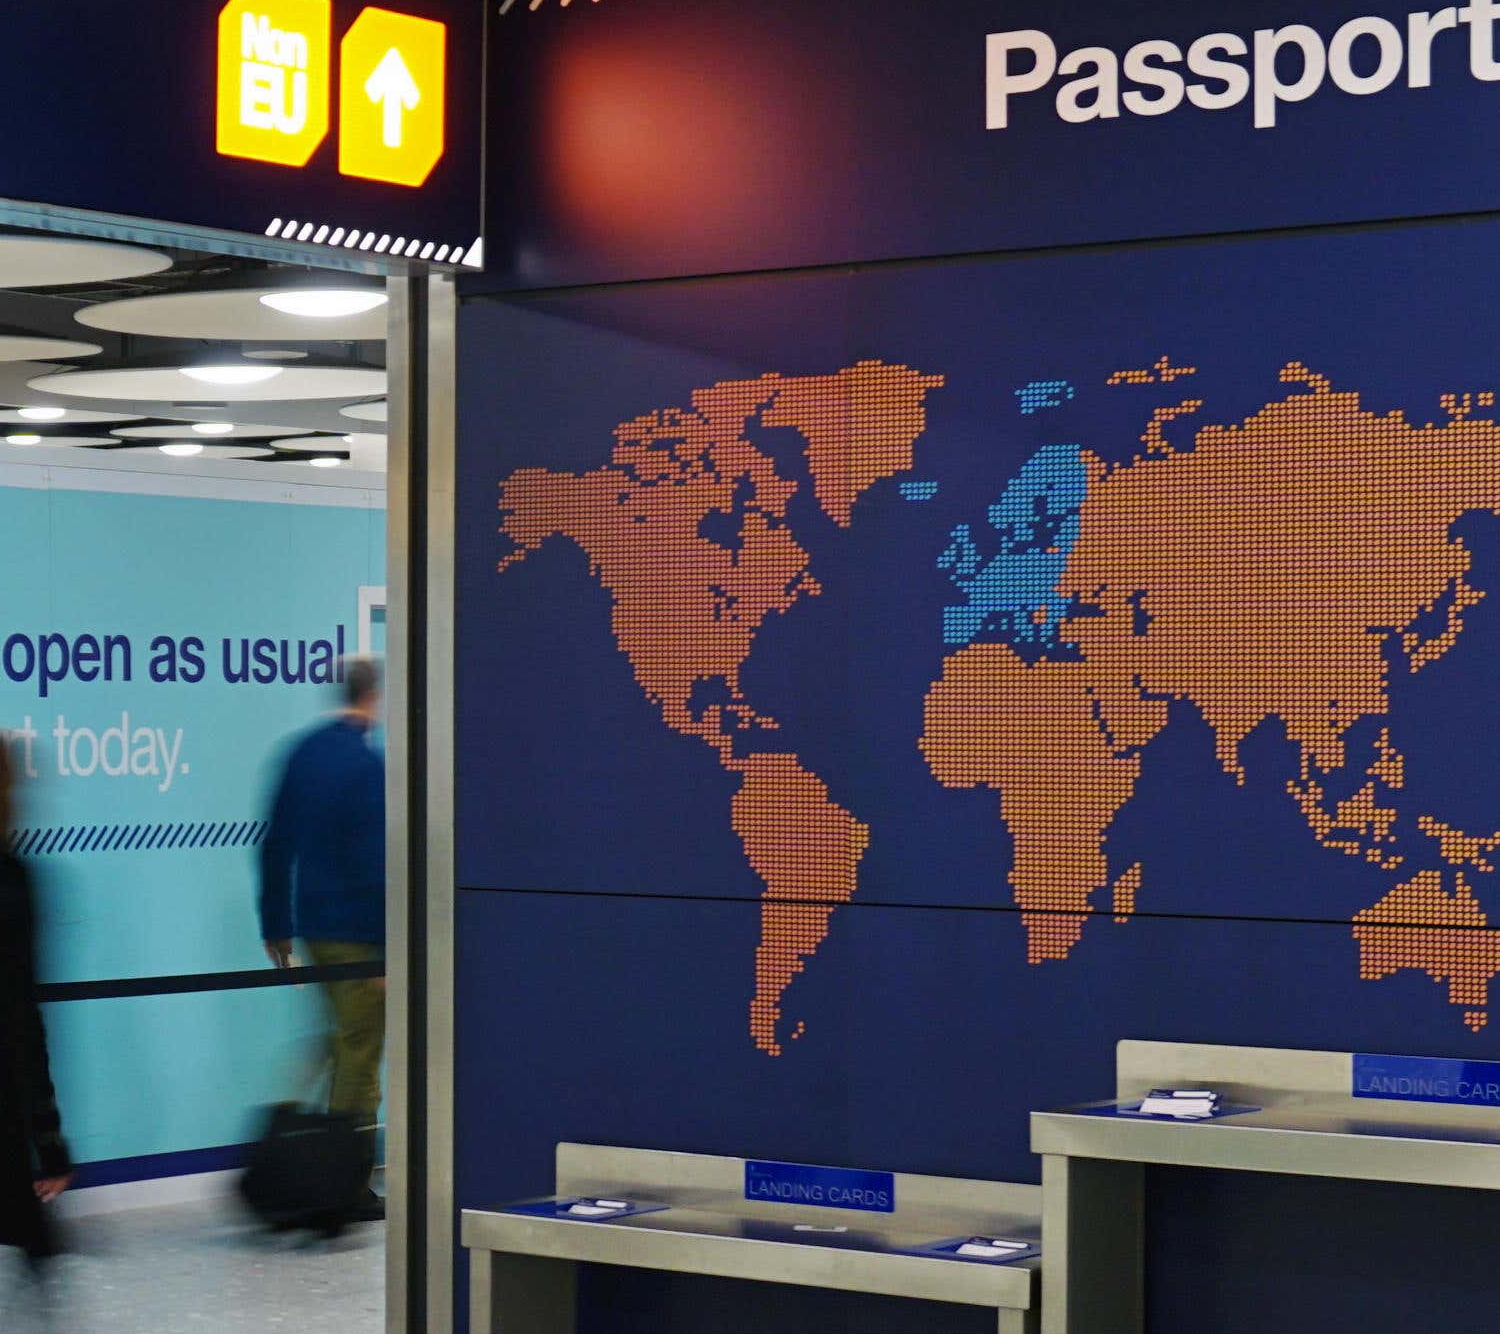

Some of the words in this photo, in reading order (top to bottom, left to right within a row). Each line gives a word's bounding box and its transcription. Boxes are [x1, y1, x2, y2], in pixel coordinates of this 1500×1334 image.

[241, 11, 308, 69] Non
[240, 61, 308, 135] EU
[1, 631, 132, 698] open
[149, 633, 206, 683] as
[220, 624, 345, 684] usual
[53, 708, 191, 793] today.
[1358, 1075, 1449, 1098] LANDING
[750, 1180, 824, 1201] LANDING
[828, 1186, 889, 1208] CARDS
